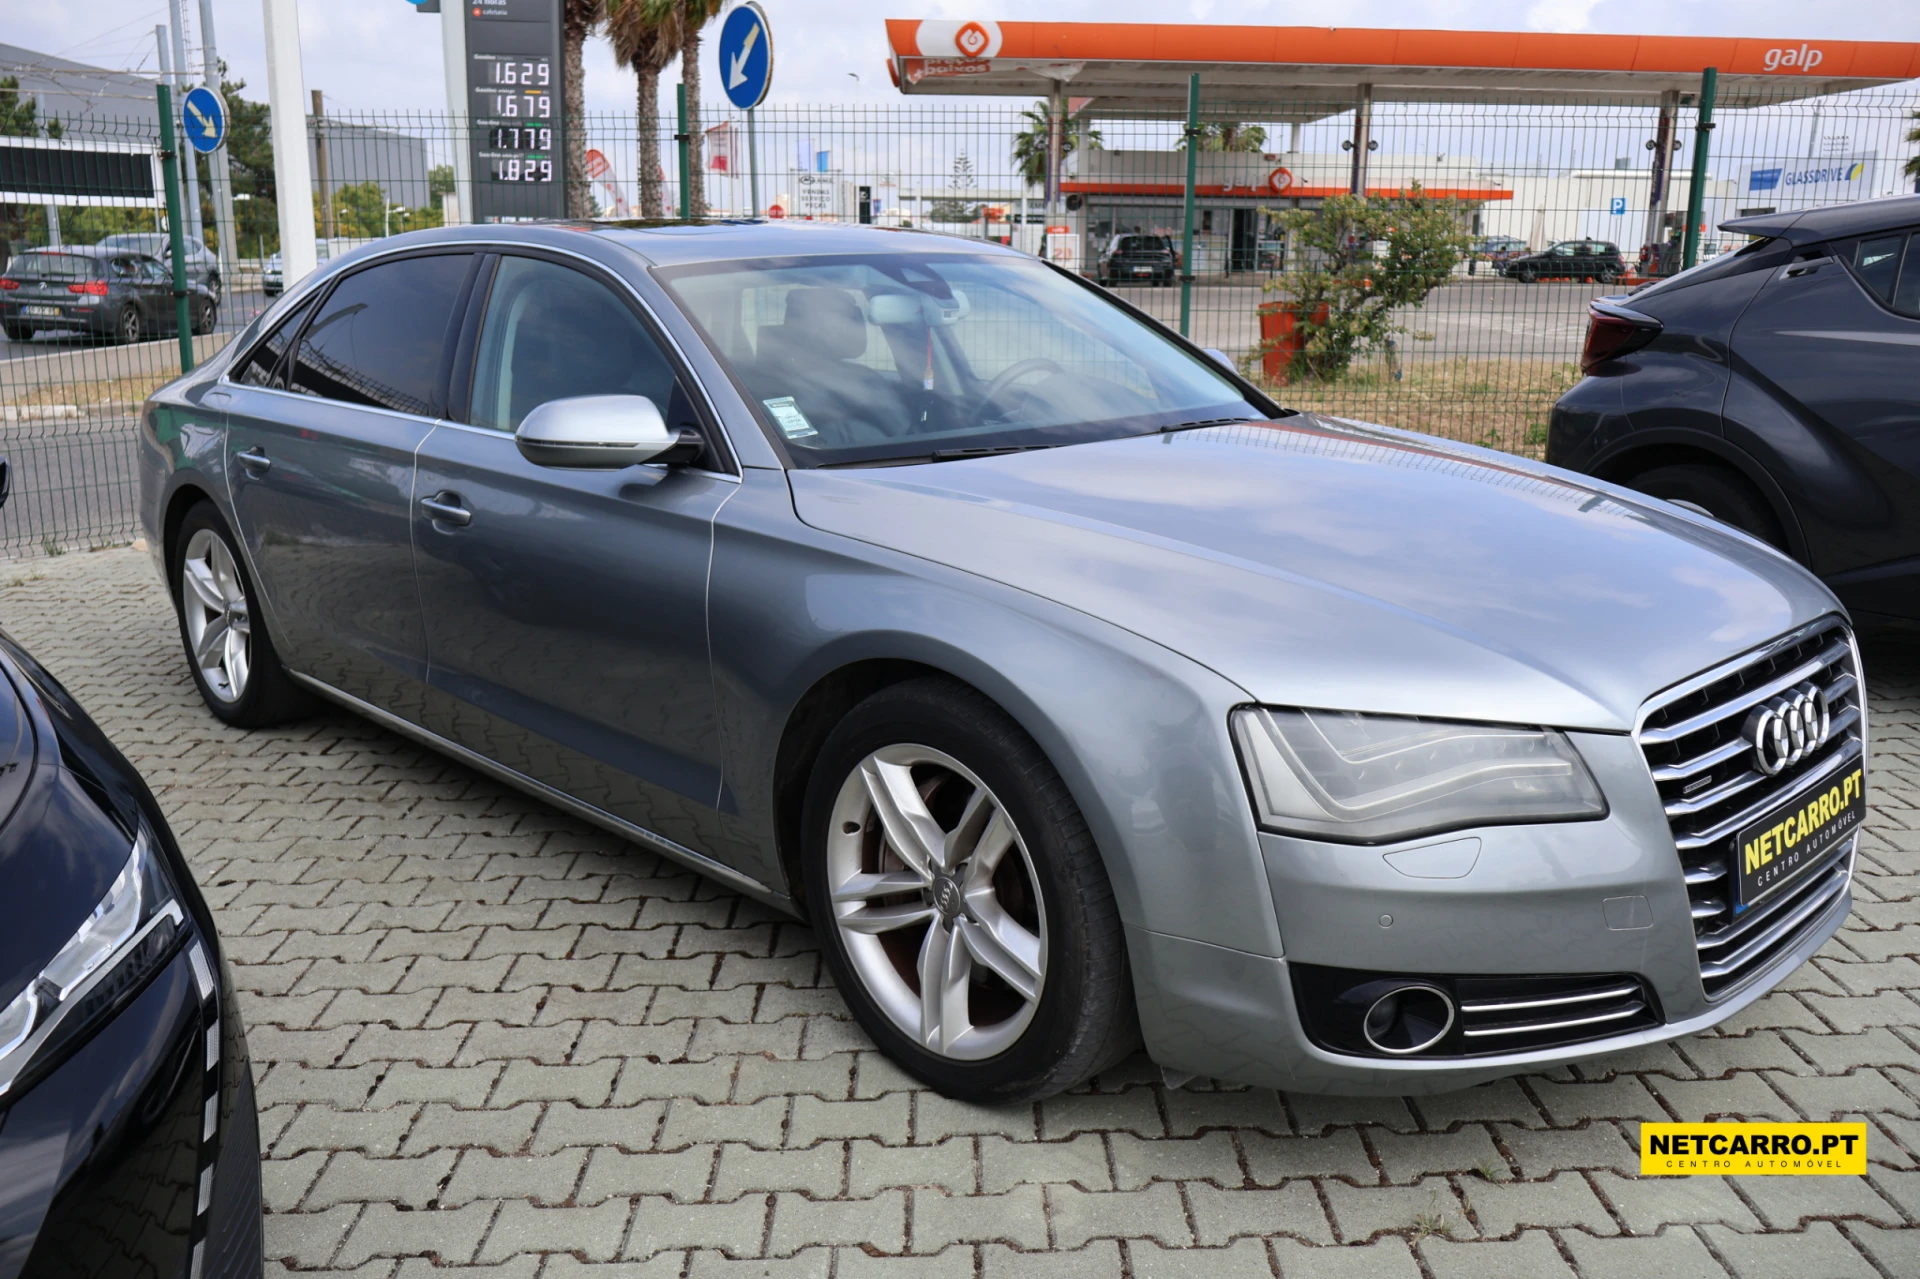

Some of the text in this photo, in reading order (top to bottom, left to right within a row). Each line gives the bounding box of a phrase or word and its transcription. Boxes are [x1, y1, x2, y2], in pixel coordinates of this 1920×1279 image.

[1763, 43, 1823, 72] galp
[495, 62, 550, 85] 1.629
[496, 95, 550, 118] 1.679
[497, 128, 552, 150] 1.779
[498, 159, 552, 182] 1.829
[1785, 167, 1843, 186] GLASSDRIVE
[1613, 199, 1624, 214] P
[1745, 769, 1861, 875] NETCARRO.PT
[1757, 811, 1855, 886] CENTRO AUTOMÓVEL
